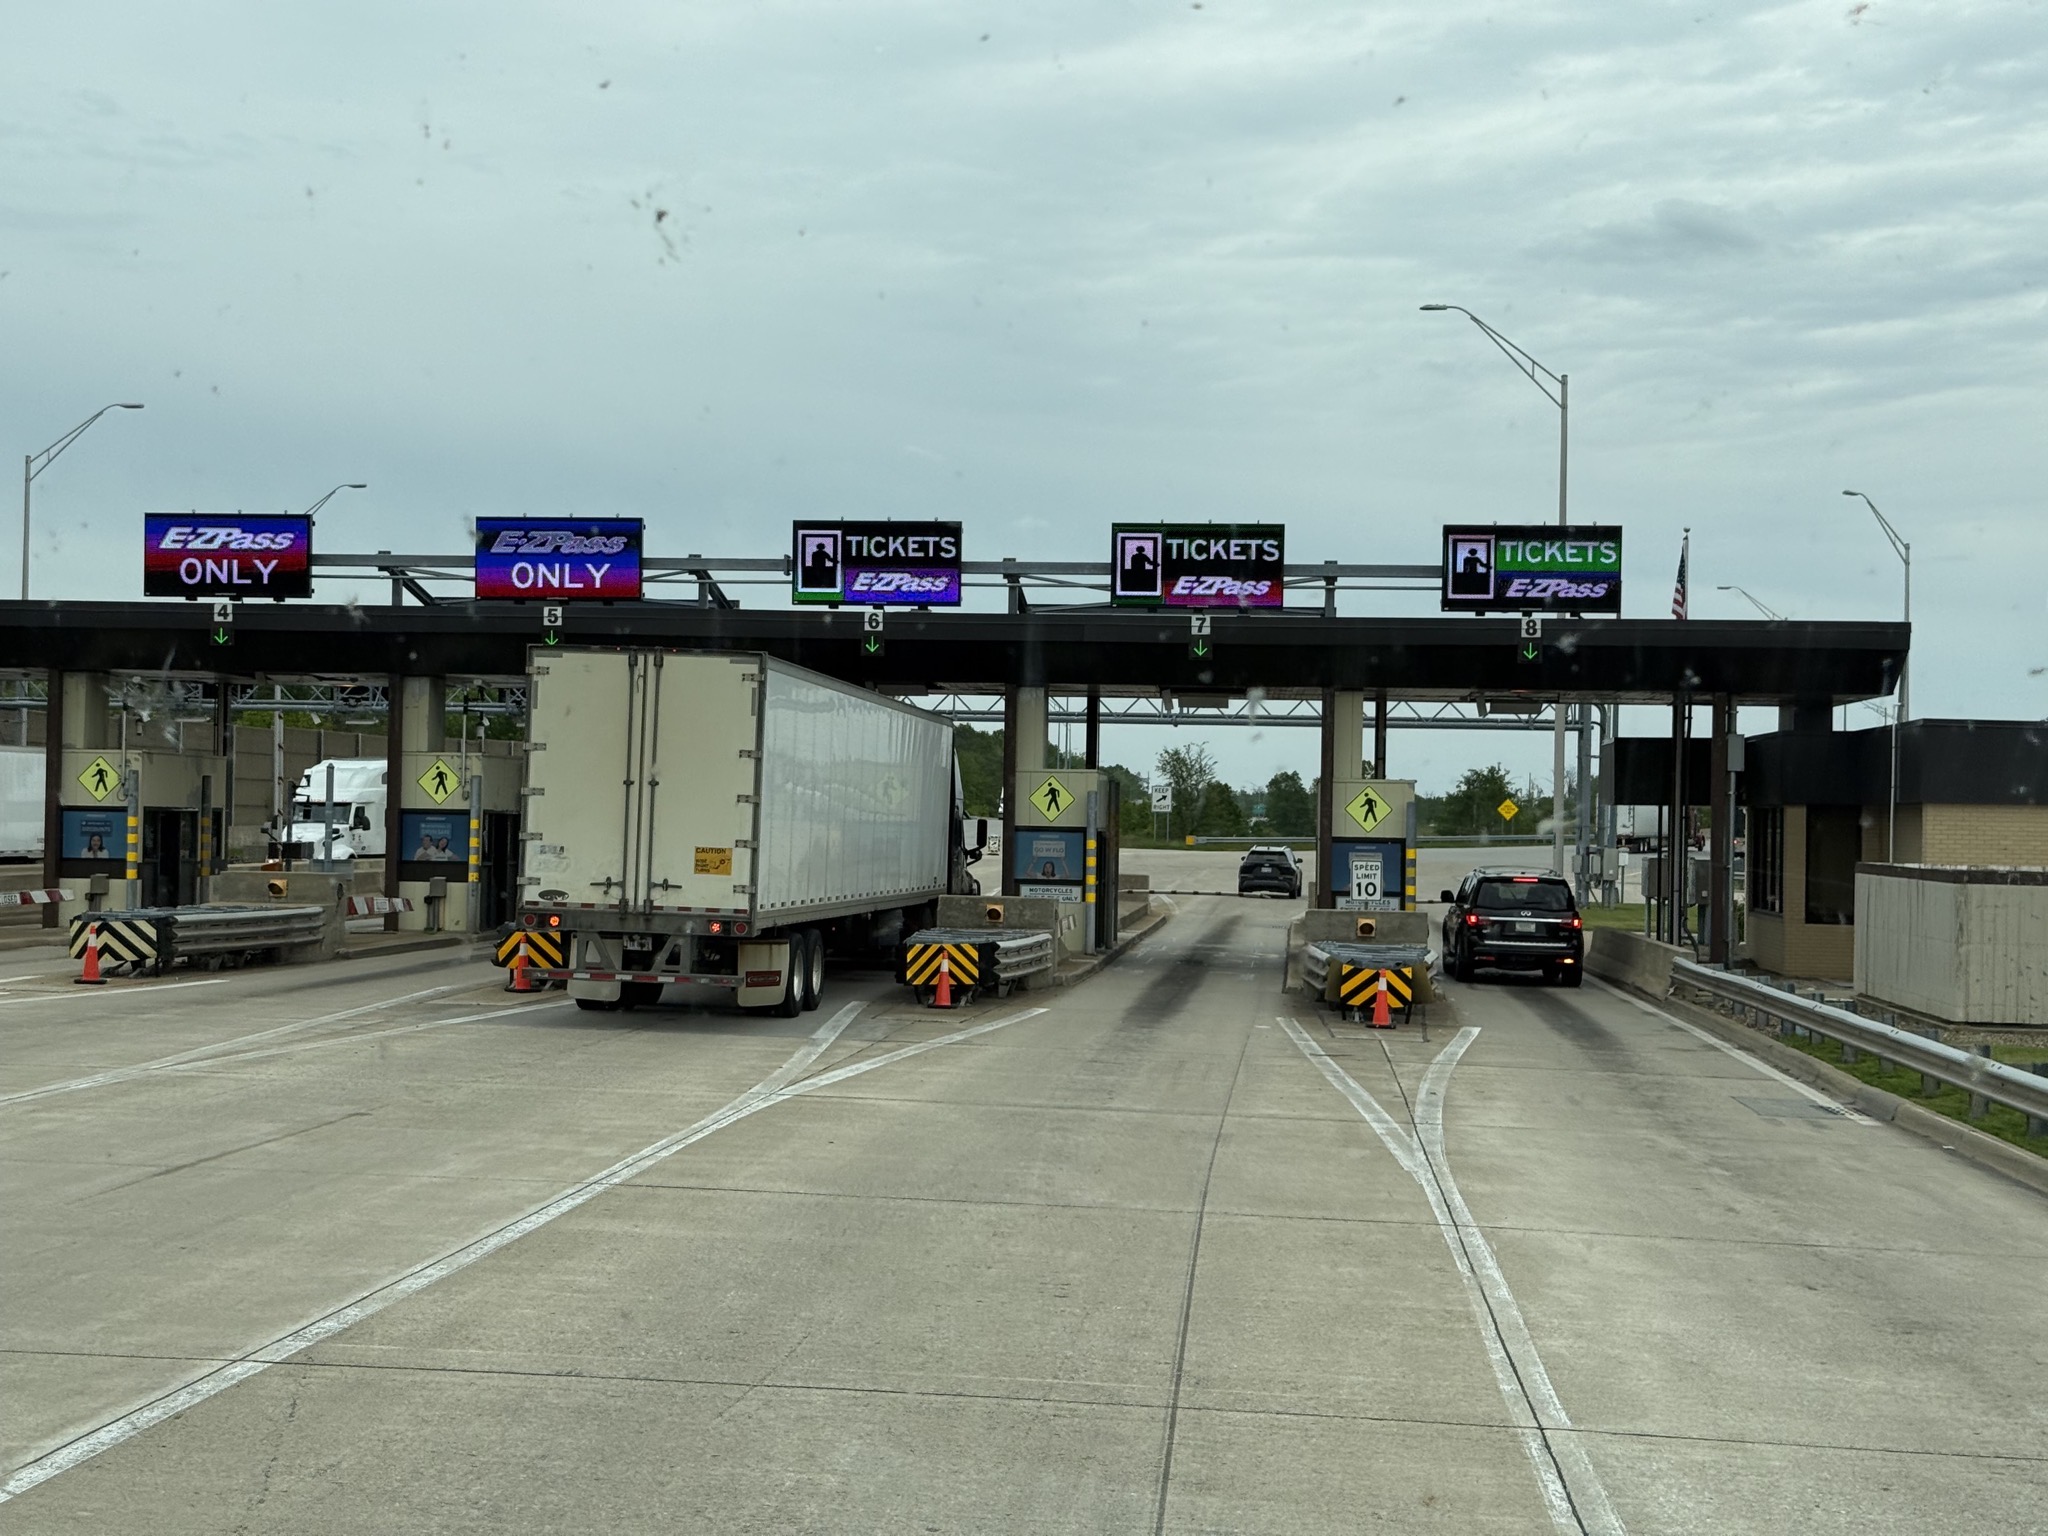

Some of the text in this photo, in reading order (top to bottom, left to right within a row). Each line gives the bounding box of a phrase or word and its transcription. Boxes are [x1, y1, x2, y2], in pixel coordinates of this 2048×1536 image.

[845, 535, 957, 559] TICKETS
[1165, 538, 1280, 562] TICKETS
[1498, 541, 1617, 564] TICKETS
[179, 557, 279, 585] ONLY
[511, 561, 612, 589] ONLY
[217, 604, 229, 621] 4
[547, 608, 559, 625] 5
[867, 613, 880, 630] 6
[1195, 617, 1207, 633] 7
[1525, 619, 1538, 637] 8
[695, 847, 727, 855] CAUTION
[1355, 872, 1377, 880] LIMIT
[1355, 881, 1377, 897] 10
